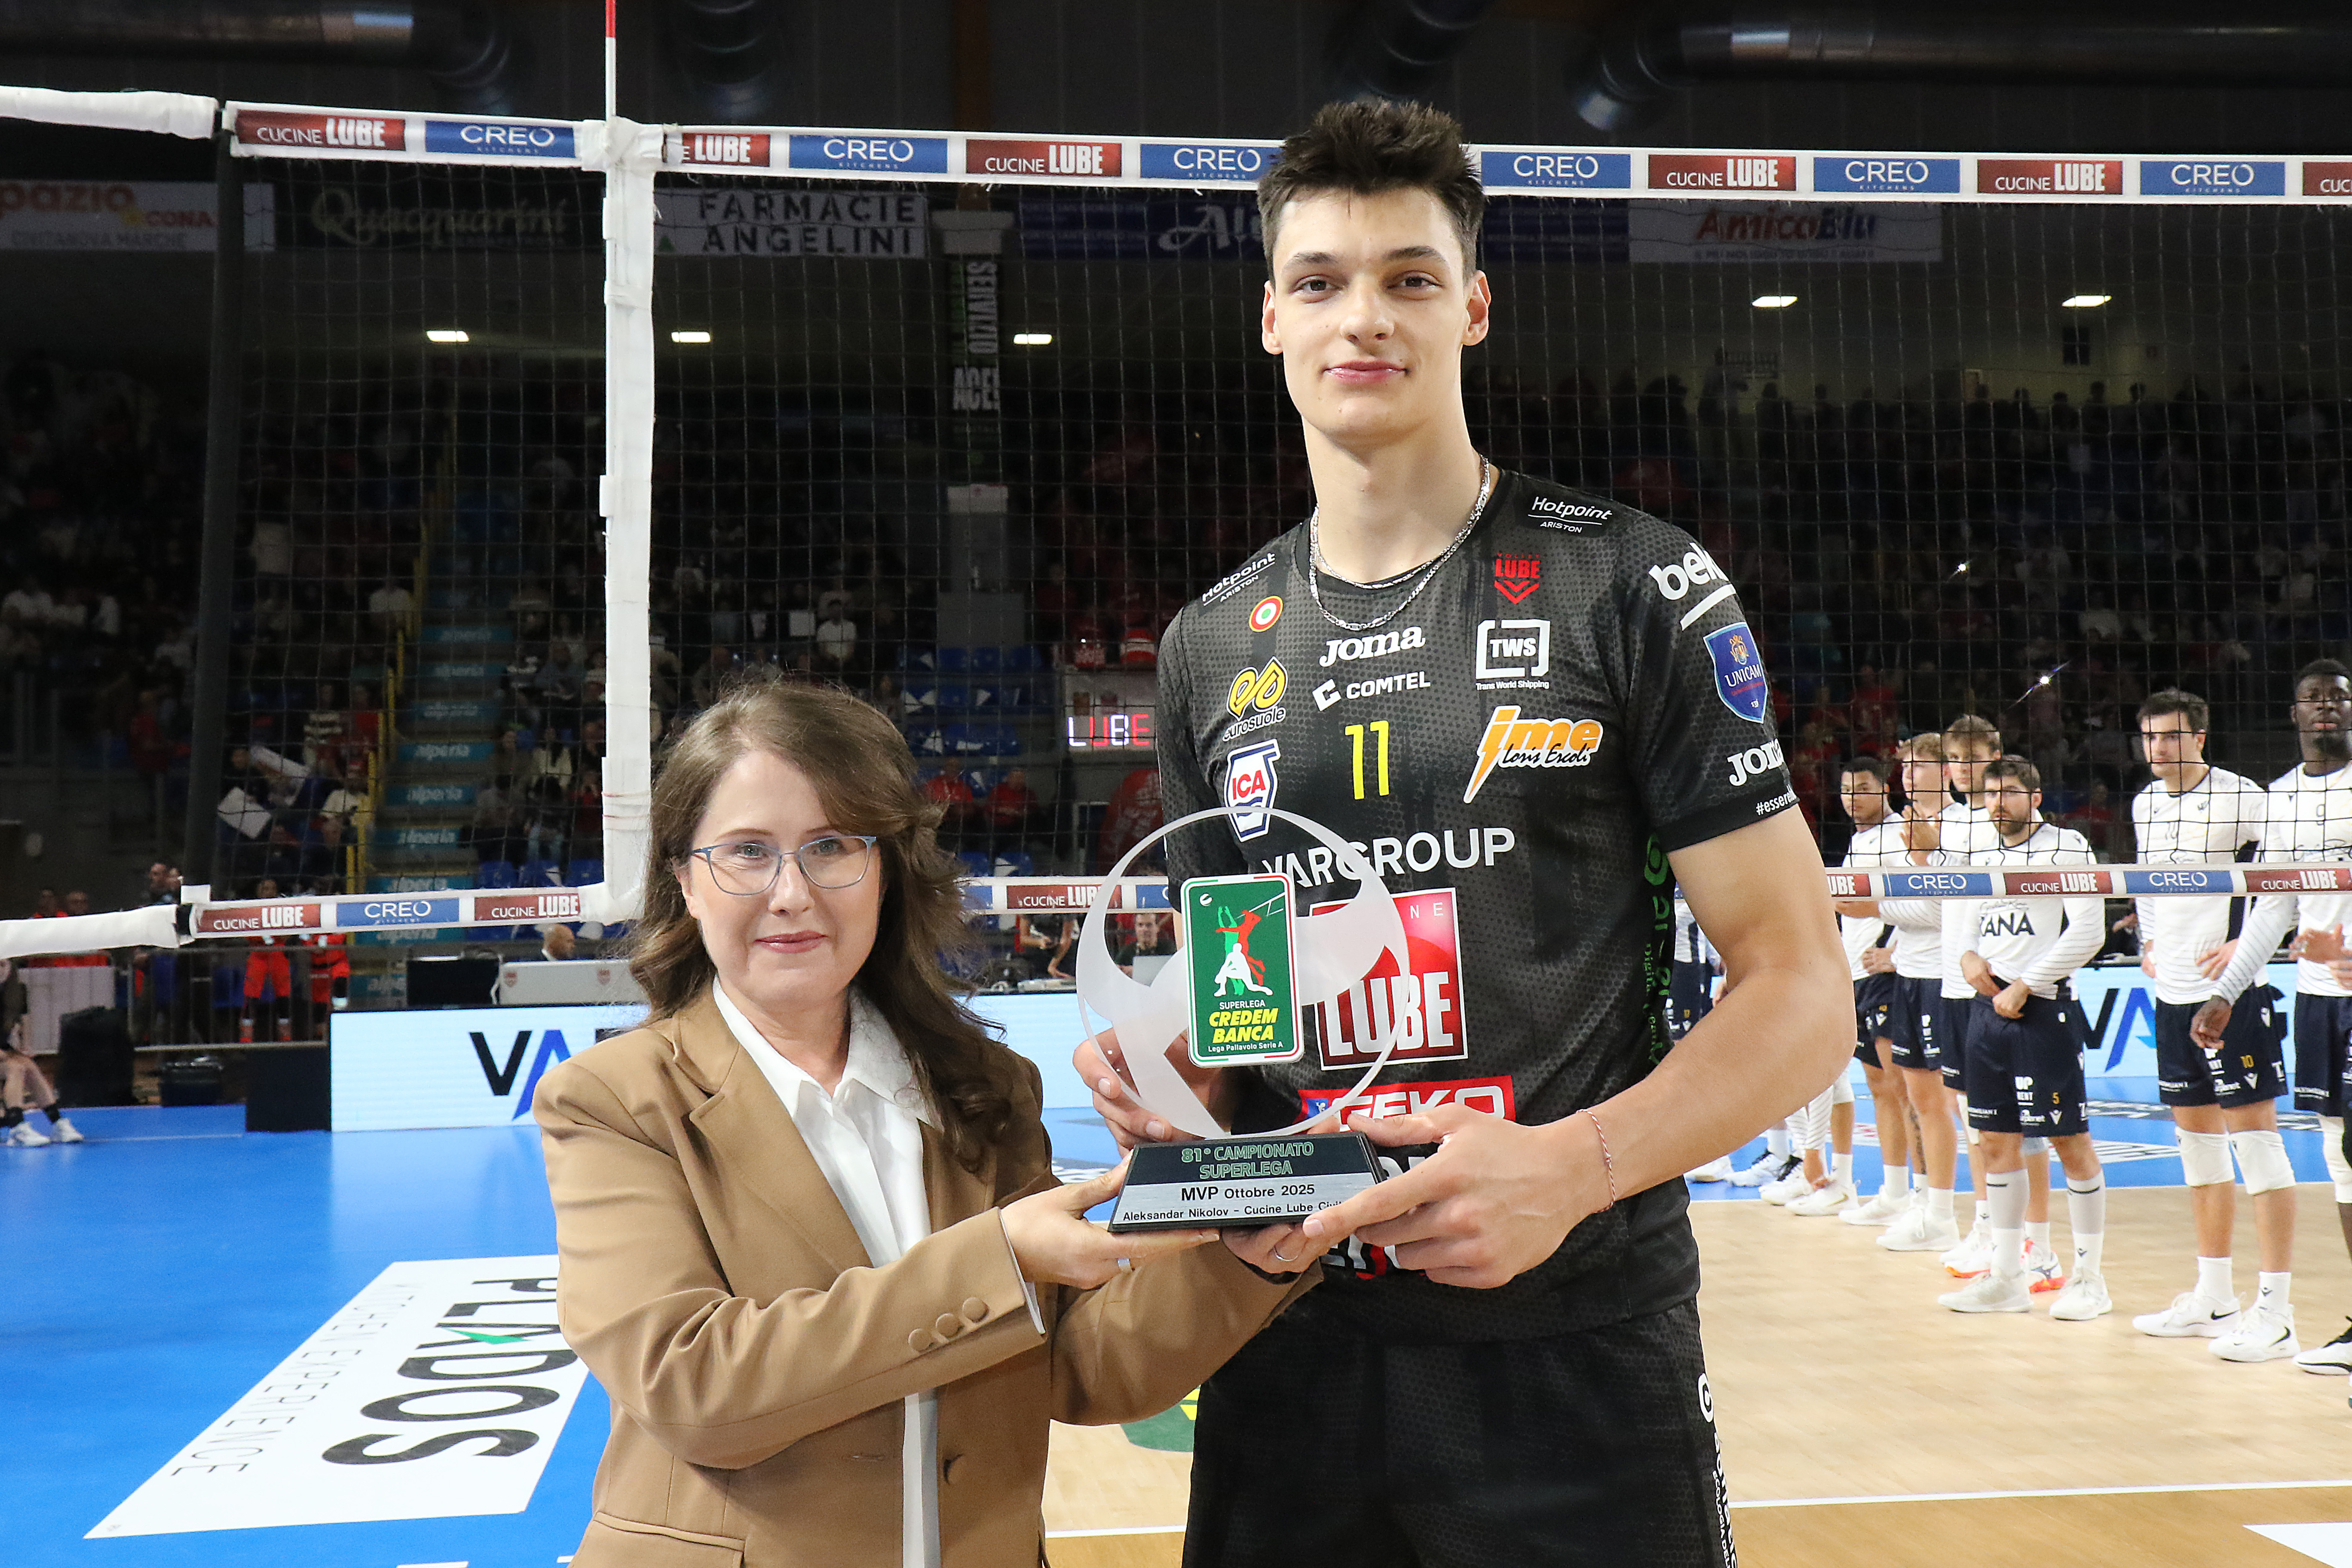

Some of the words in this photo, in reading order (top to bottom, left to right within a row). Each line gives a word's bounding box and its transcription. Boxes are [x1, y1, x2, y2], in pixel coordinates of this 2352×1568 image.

[257, 127, 323, 144] CUCINE
[326, 118, 385, 147] LUBE
[460, 126, 554, 147] CREO
[694, 135, 751, 163] LUBE
[824, 139, 913, 162] CREO
[985, 157, 1044, 172] CUCINE
[1049, 144, 1103, 174] LUBE
[1173, 148, 1261, 172] CREO
[1513, 155, 1599, 179] CREO
[1666, 172, 1723, 187] CUCINE
[1726, 158, 1778, 188] LUBE
[1845, 161, 1929, 184] CREO
[1994, 177, 2051, 190] CUCINE
[2054, 163, 2105, 192] LUBE
[2171, 164, 2254, 187] CREO
[2320, 179, 2352, 193] CUC
[700, 193, 916, 223] FARMACIE
[1695, 206, 1877, 240] AmicoBlu
[705, 225, 911, 254] ANGELINI
[1531, 496, 1613, 520] Hotpoint
[1540, 521, 1583, 533] ARISTON
[1202, 553, 1276, 602] Hotpoint
[1495, 559, 1541, 579] LUBE
[1648, 542, 1730, 600] bek
[1220, 575, 1259, 602] ARISTON
[1490, 637, 1537, 658] TWS
[1346, 671, 1431, 699] COMTEL
[1476, 682, 1495, 690] Trans
[1496, 681, 1517, 689] World
[1518, 680, 1550, 689] Shipping
[1724, 664, 1762, 687] UNICAM
[1067, 714, 1150, 747] LUBE
[1223, 706, 1286, 742] eurosuole
[413, 744, 470, 761] alperia
[1344, 720, 1389, 800] 11
[1503, 743, 1541, 764] Loris
[1544, 743, 1590, 764] Ercoli
[407, 785, 463, 805] alperia
[1232, 769, 1266, 800] ICA
[1827, 875, 1856, 895] UBE
[1908, 874, 1967, 891] CREO
[2020, 882, 2060, 893] CUCINE
[2060, 873, 2098, 892] LUBE
[2149, 872, 2208, 888] CREO
[2261, 879, 2300, 890] CUCINE
[2300, 870, 2339, 890] LUBE
[491, 906, 536, 918] CUCINE
[538, 895, 579, 916] LUBE
[1023, 895, 1066, 907] CUCINE
[1067, 886, 1101, 906] LUB
[213, 918, 259, 930] CUCINE
[261, 906, 304, 928] LUBE
[364, 900, 431, 919] CREO
[1980, 911, 2036, 937] ANA
[1219, 999, 1265, 1010] SUPERLEGA
[1323, 971, 1455, 1057] LUBE
[1208, 1008, 1279, 1028] CREDEM
[1212, 1024, 1274, 1044] BANCA
[1226, 1043, 1258, 1052] Pallavolo
[2240, 1054, 2254, 1069] 10
[2014, 1076, 2034, 1090] UP
[2052, 1092, 2060, 1105] 5
[1181, 1147, 1211, 1163] 81°
[1213, 1141, 1314, 1161] CAMPIONATO
[1199, 1160, 1293, 1179] SUPERLEGA
[1181, 1186, 1219, 1202] MVP
[1224, 1187, 1275, 1199] Ottobre
[1281, 1184, 1315, 1196] 2025
[1123, 1209, 1184, 1222] Aleksandar
[1188, 1207, 1229, 1218] Nikolov
[1244, 1204, 1282, 1216] Cucine
[1286, 1202, 1314, 1212] Lube
[170, 1349, 363, 1477] EXPERIENCE
[1712, 1470, 1725, 1539] ECOLOGIA
